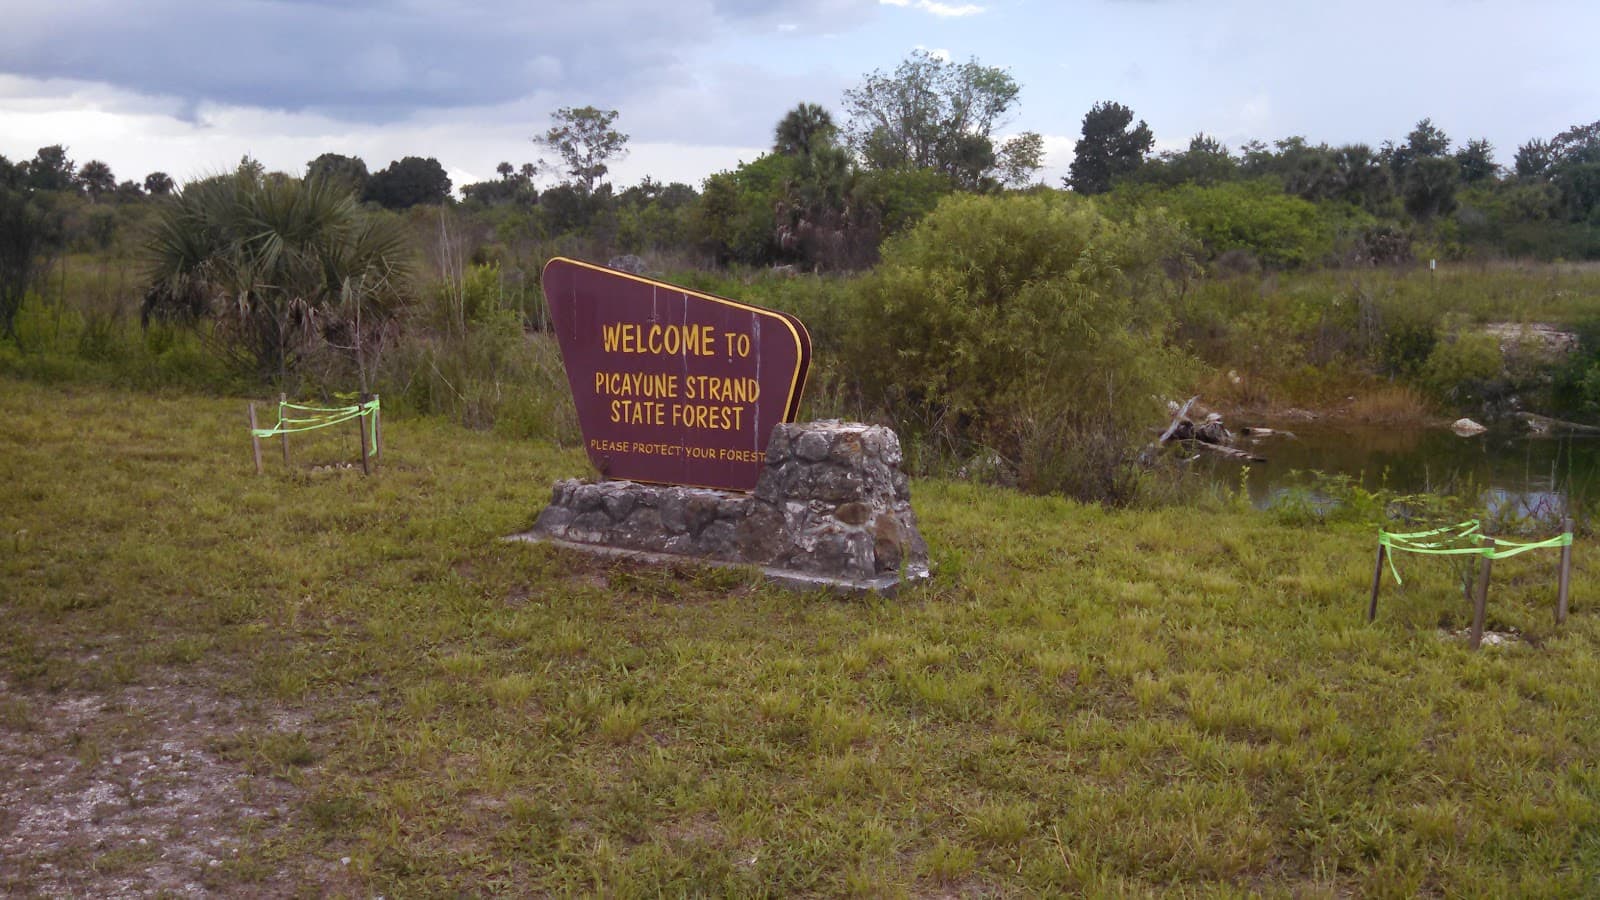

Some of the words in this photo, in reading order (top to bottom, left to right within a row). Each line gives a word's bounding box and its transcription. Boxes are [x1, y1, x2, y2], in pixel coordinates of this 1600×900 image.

[602, 321, 715, 356] WELCOME
[725, 332, 750, 357] TO
[595, 372, 678, 399] PICAYUNE
[685, 375, 760, 404] STRAND
[611, 400, 665, 425] STATE
[673, 404, 743, 430] FOREST
[591, 440, 629, 452] PLEASE
[633, 442, 681, 456] PROTECT
[685, 447, 716, 458] YOUR
